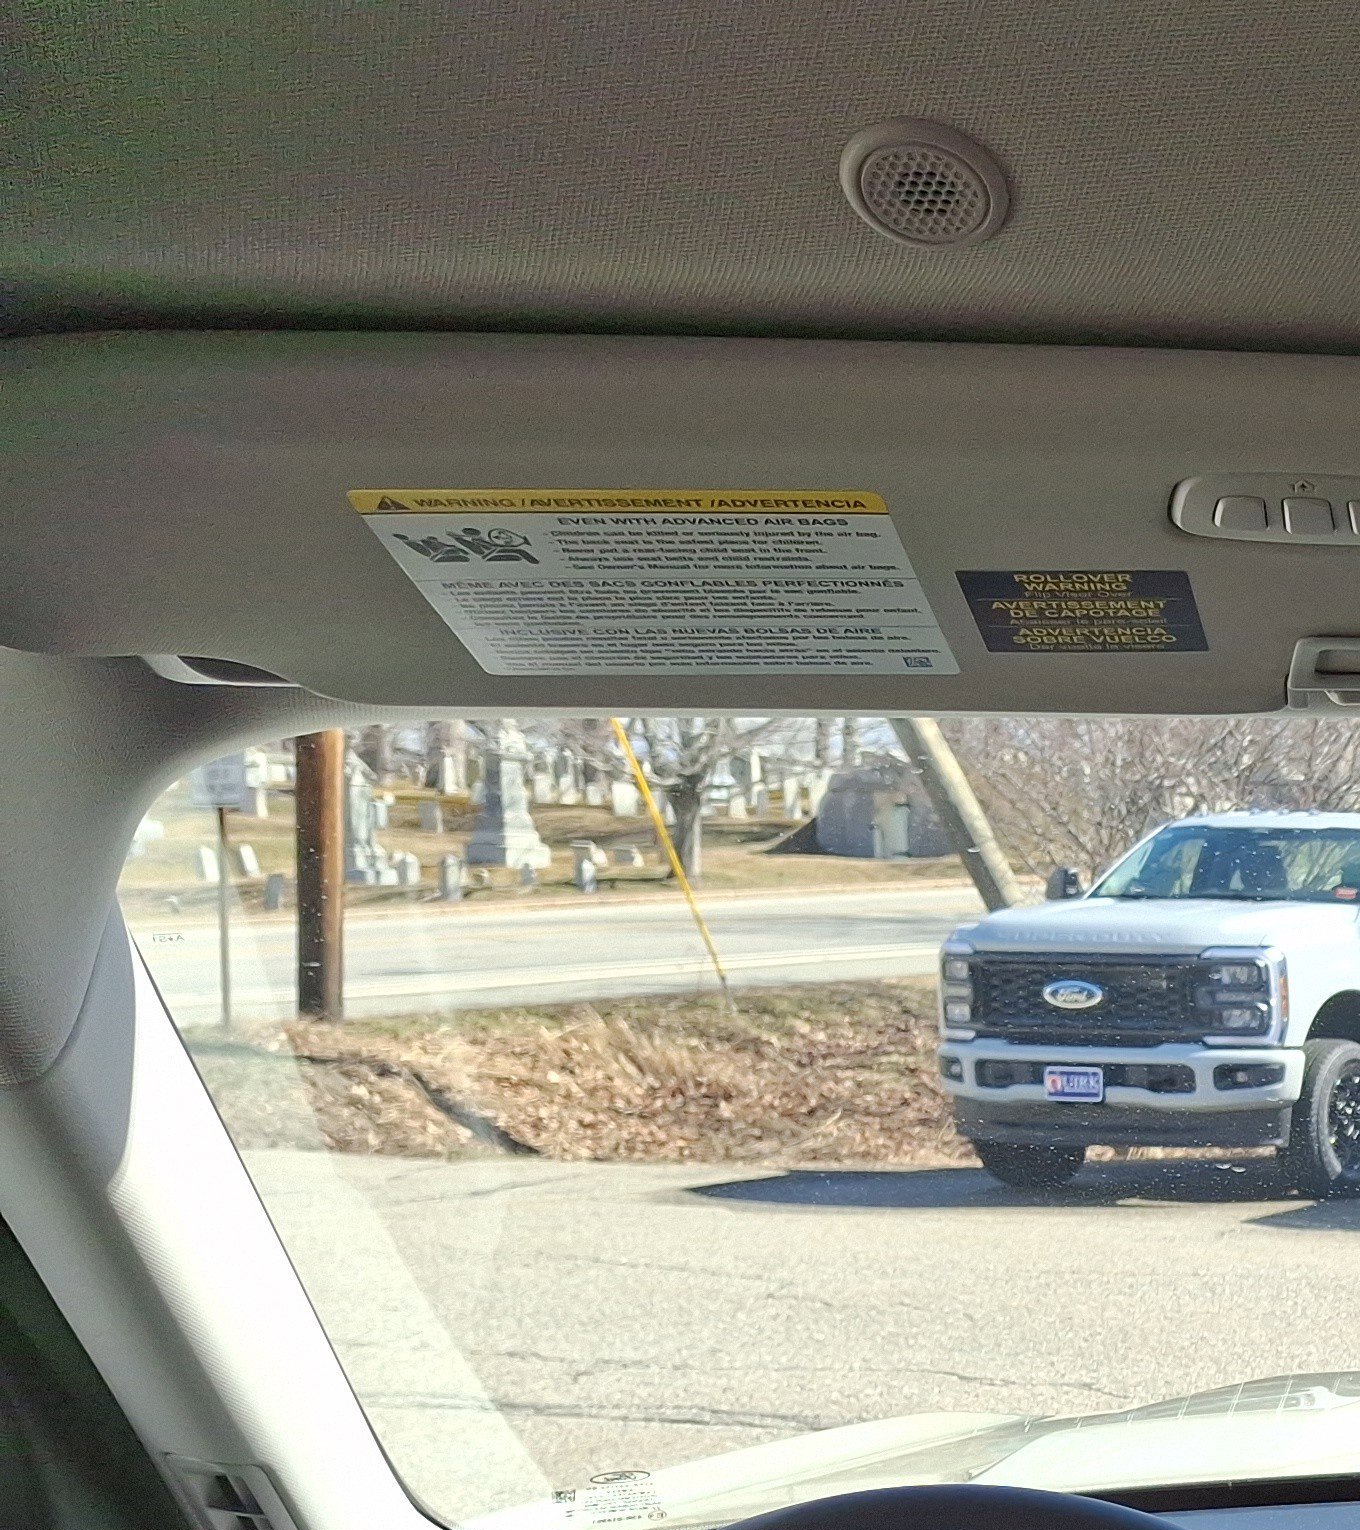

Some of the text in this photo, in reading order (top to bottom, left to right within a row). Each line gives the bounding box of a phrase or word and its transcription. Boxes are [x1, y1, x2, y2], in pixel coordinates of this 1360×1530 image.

[414, 498, 517, 508] WARNING
[558, 517, 606, 526] EVEN
[610, 517, 656, 526] WITH
[661, 517, 758, 526] ADVANCED
[764, 517, 794, 526] AIR
[1013, 573, 1132, 583] ROLLOVER
[1023, 582, 1128, 591] WARNING
[991, 600, 1167, 609] AVERTISSEMENT
[1010, 609, 1162, 618] DE CAPOTAGE
[1019, 627, 1167, 636] ADVERTENCIA
[1013, 635, 1178, 644] SOBRE VUELCO
